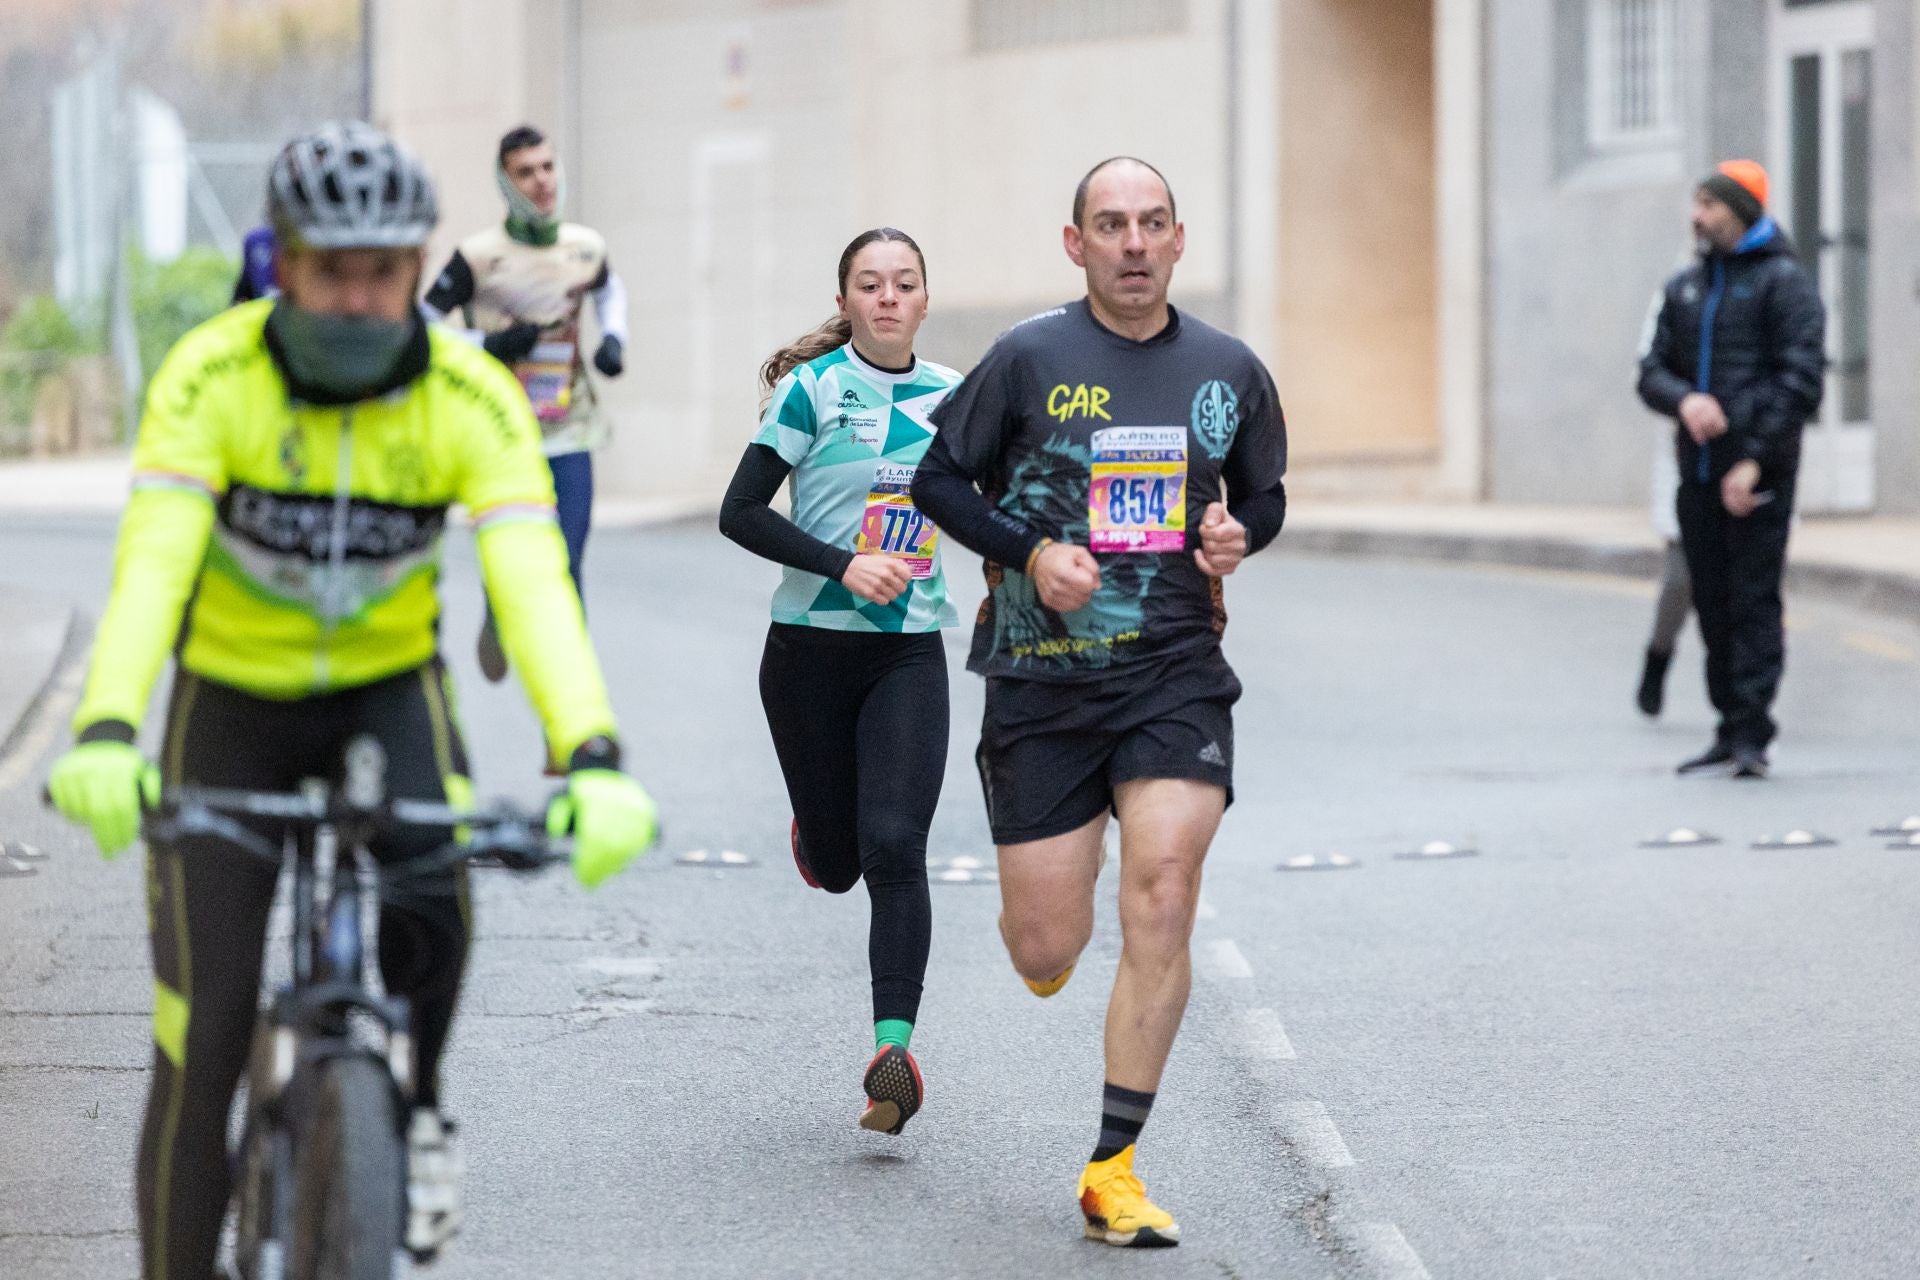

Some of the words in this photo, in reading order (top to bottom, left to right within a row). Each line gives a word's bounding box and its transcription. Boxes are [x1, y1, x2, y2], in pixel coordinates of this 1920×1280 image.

[1047, 383, 1112, 423] GAR
[1108, 432, 1180, 441] LARDERO
[1109, 478, 1166, 525] 854
[880, 508, 924, 553] 772
